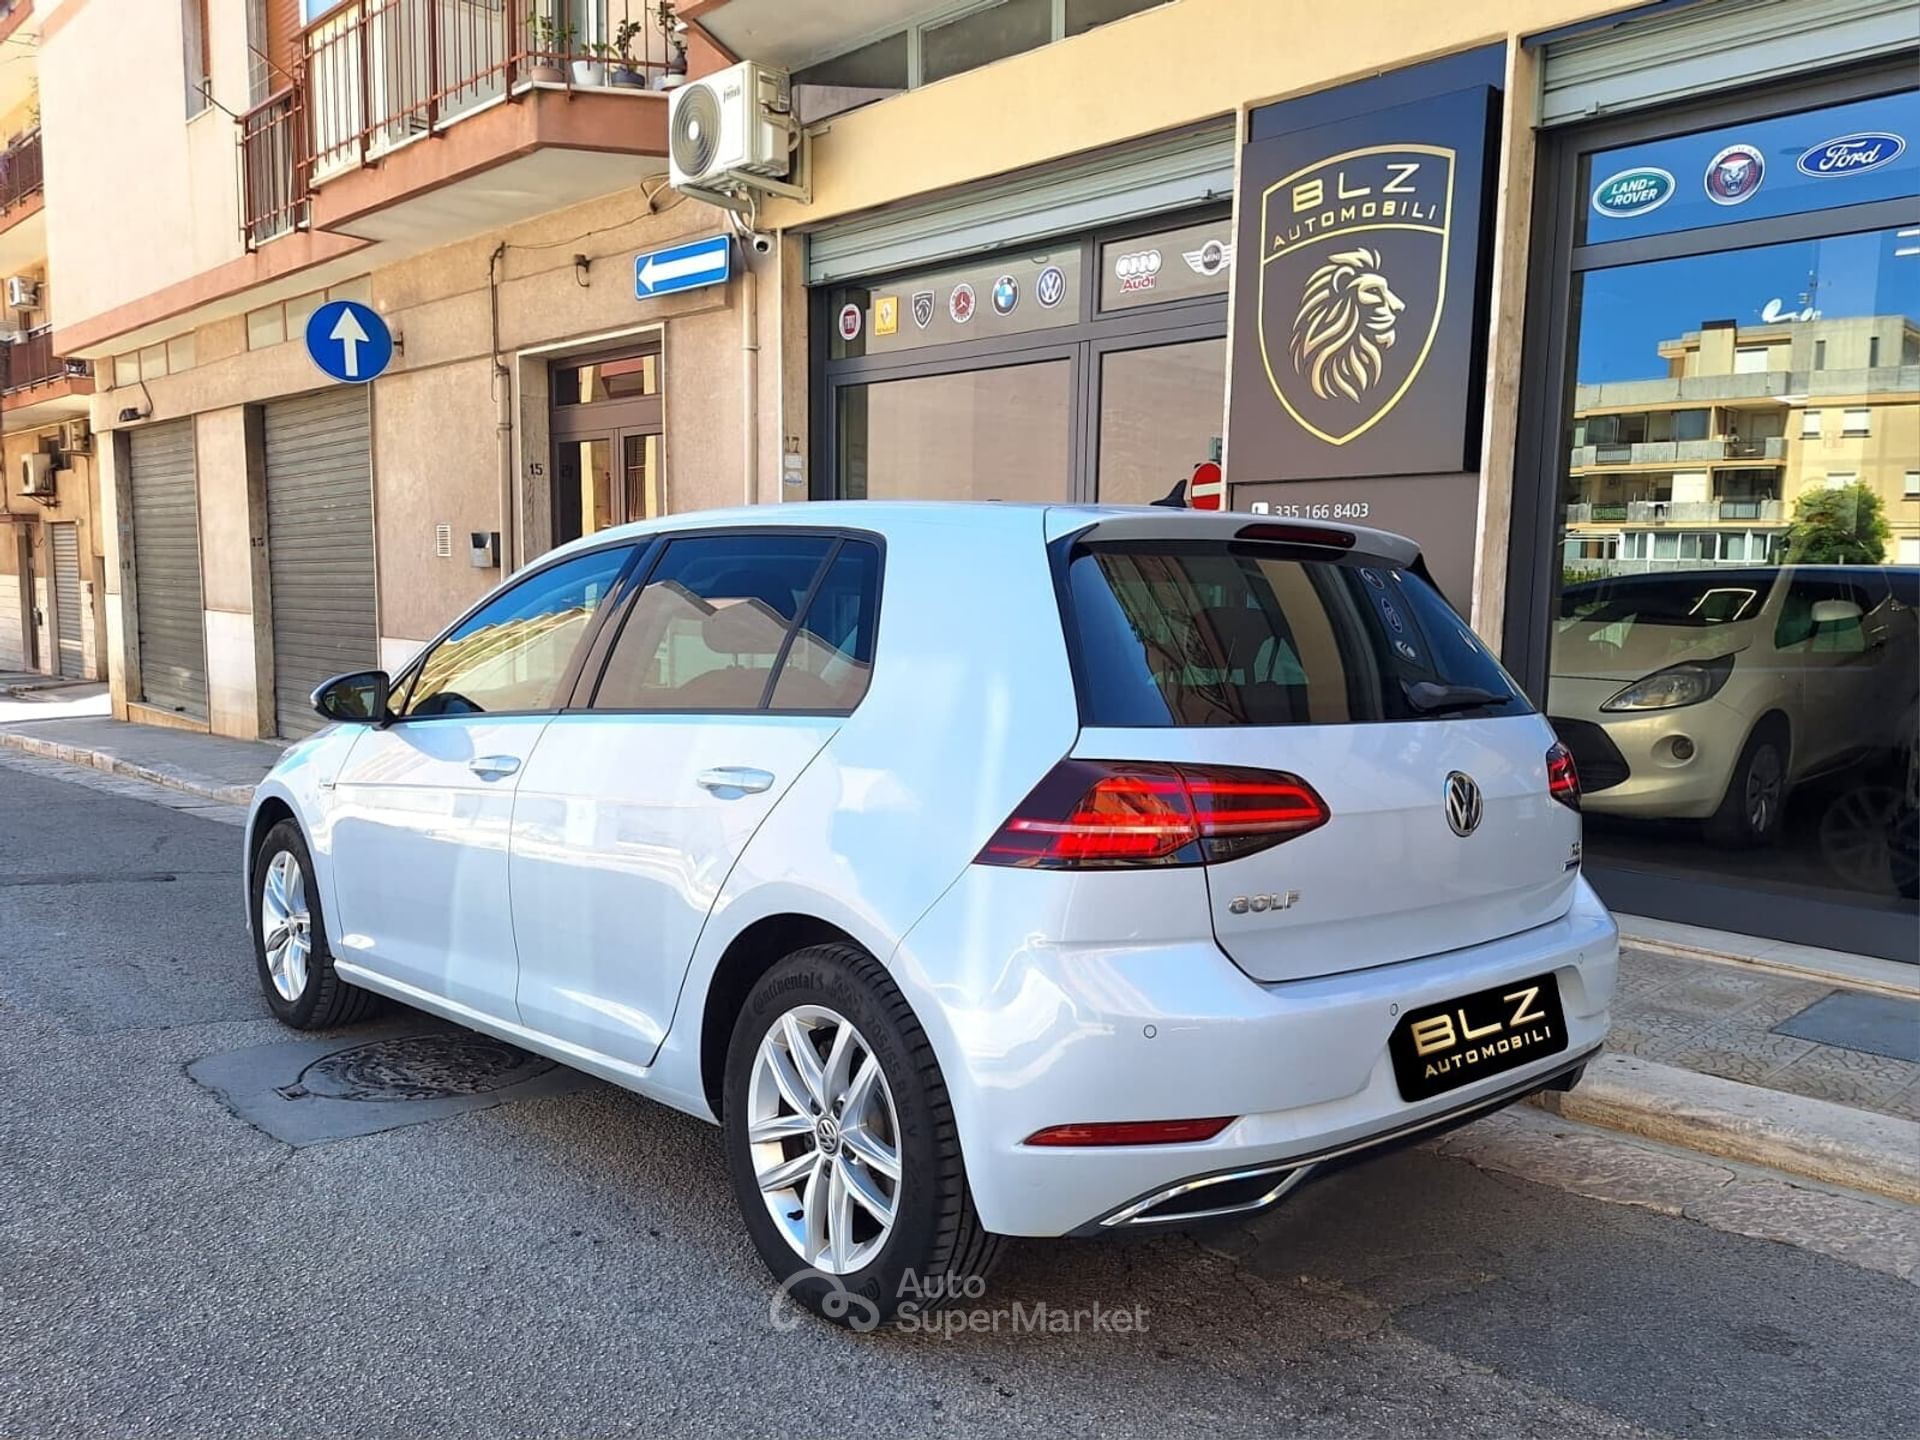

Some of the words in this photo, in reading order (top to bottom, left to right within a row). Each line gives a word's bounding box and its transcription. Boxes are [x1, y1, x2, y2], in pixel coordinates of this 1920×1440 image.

[1818, 140, 1879, 172] Ford
[1292, 162, 1421, 214] BLZ
[1272, 200, 1436, 249] AUTOMOBILI
[785, 436, 800, 453] 17
[529, 463, 543, 476] 15
[1274, 505, 1300, 518] 335
[1304, 504, 1330, 519] 166
[1333, 503, 1369, 519] 8403
[1228, 889, 1302, 915] GOLF
[1411, 986, 1546, 1058] BLZ
[1424, 1025, 1552, 1079] AUTOMOBILI
